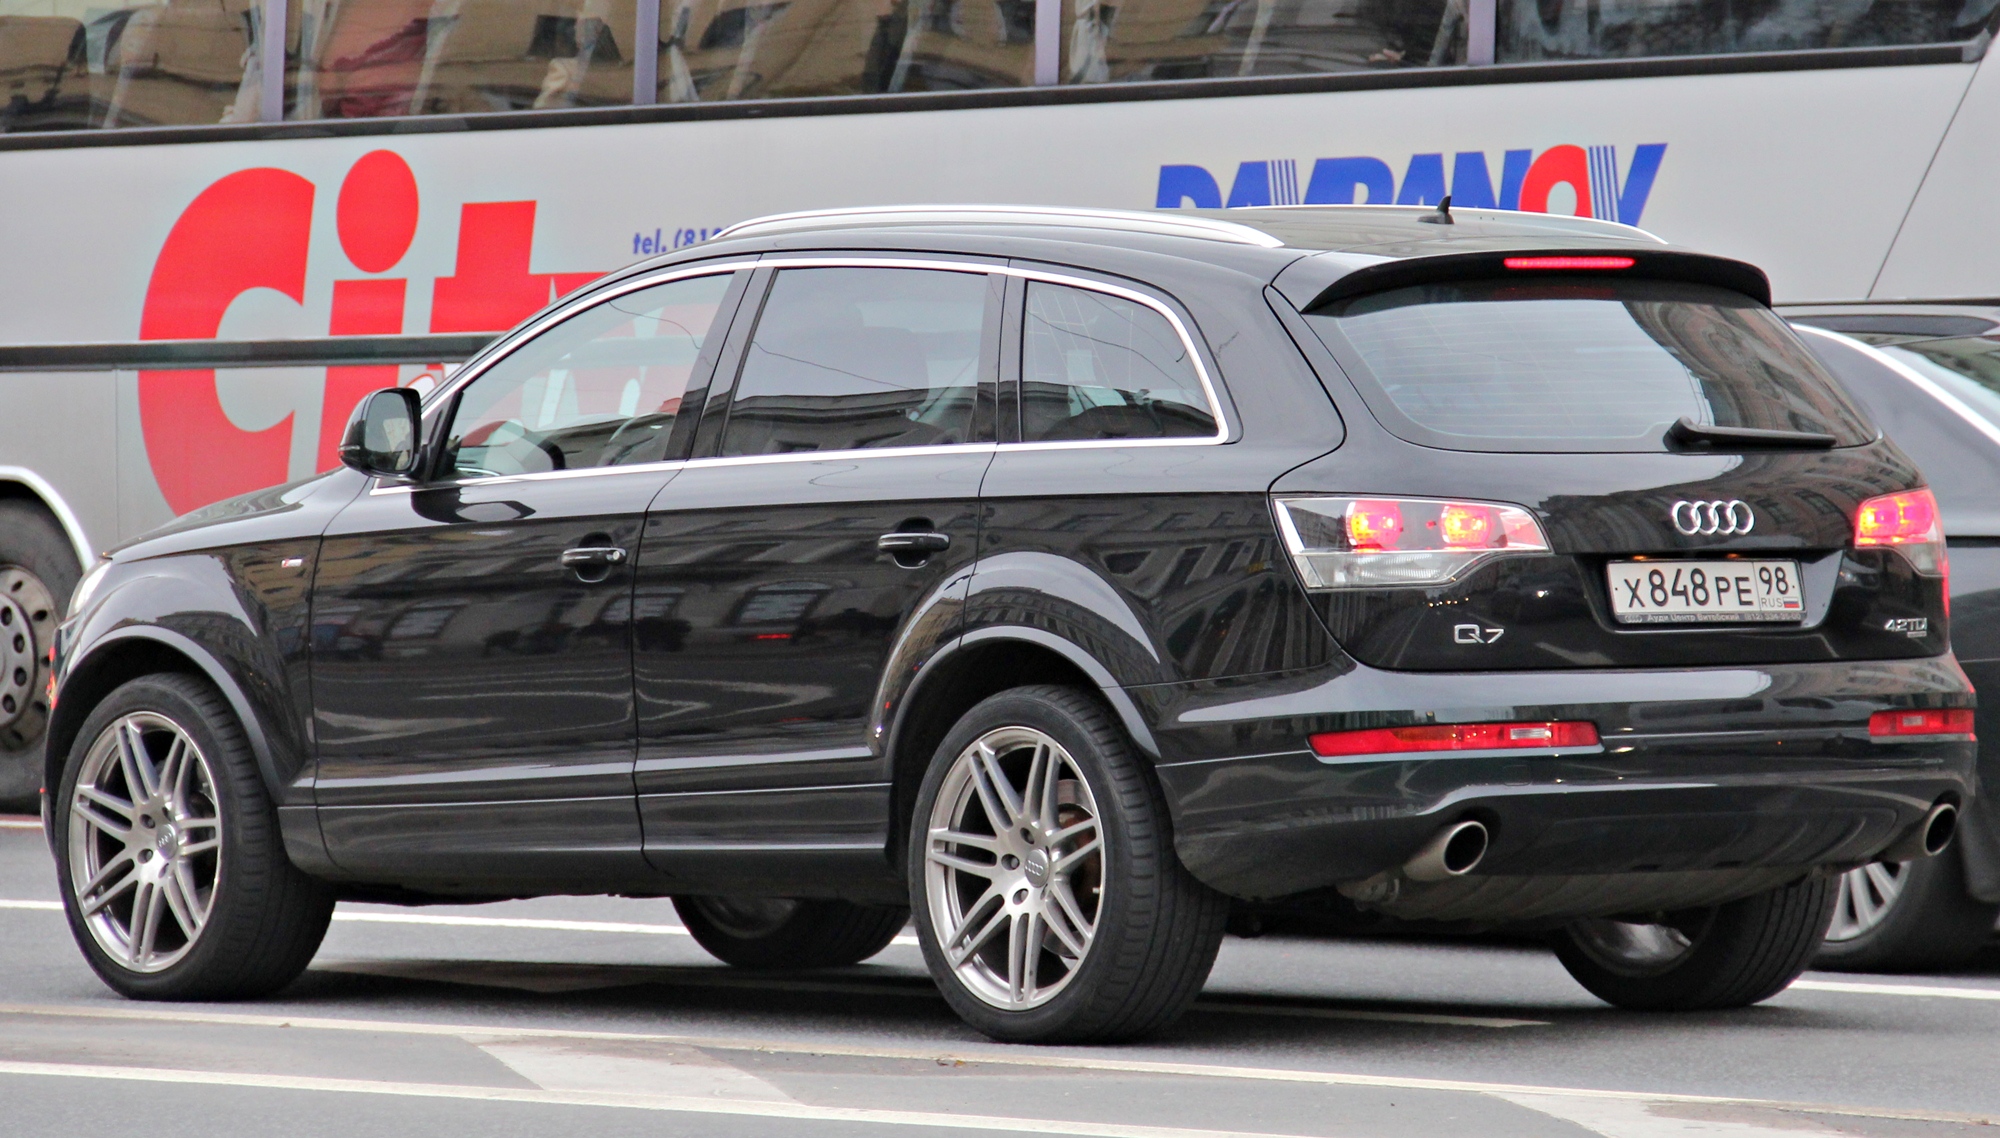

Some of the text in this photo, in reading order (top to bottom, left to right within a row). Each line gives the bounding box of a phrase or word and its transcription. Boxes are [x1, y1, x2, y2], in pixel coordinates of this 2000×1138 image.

[633, 228, 667, 255] tel.
[1759, 566, 1789, 595] 98
[1761, 597, 1783, 608] RUS
[1454, 623, 1505, 645] Q7
